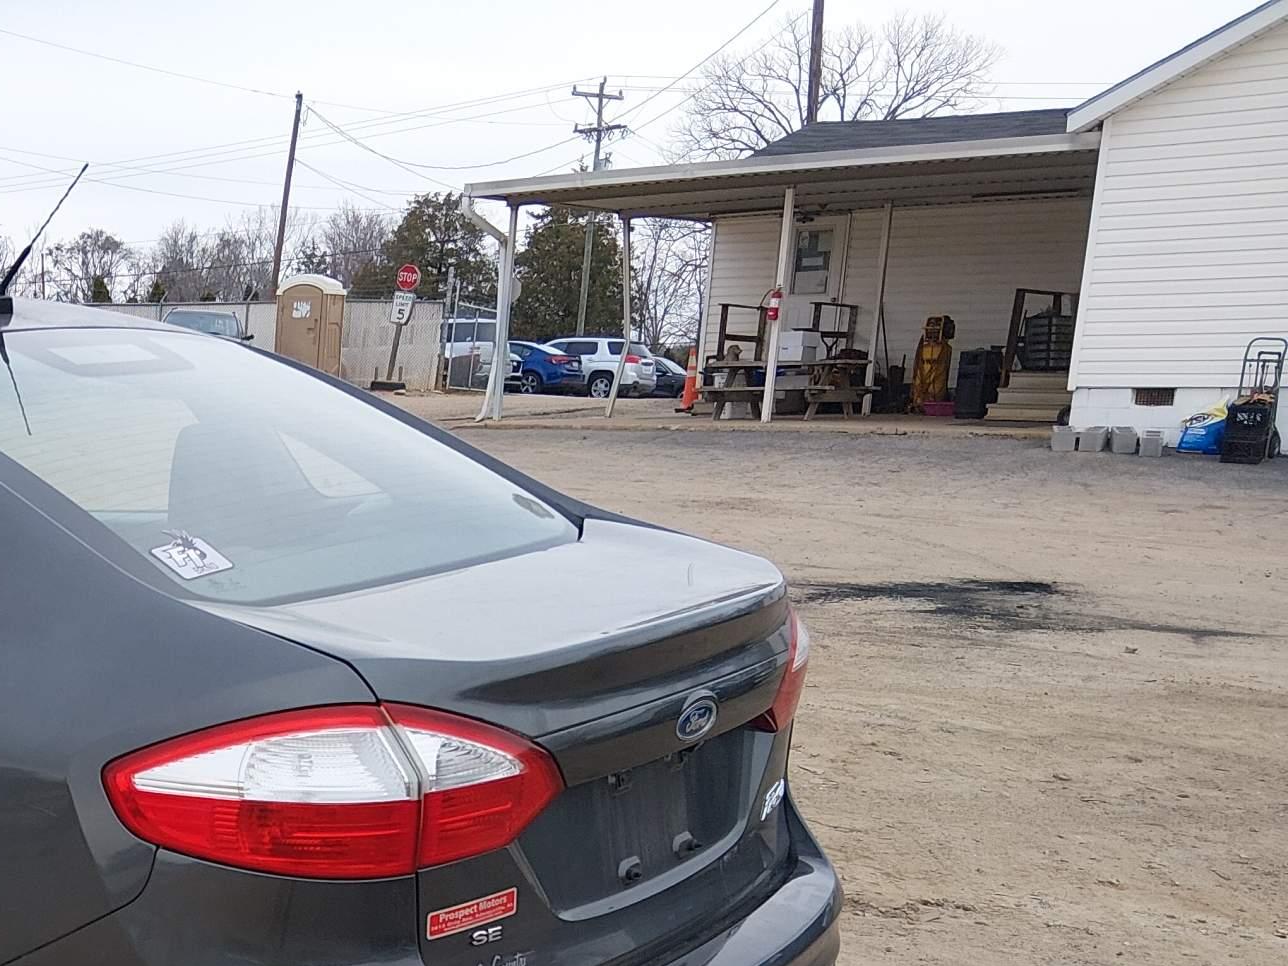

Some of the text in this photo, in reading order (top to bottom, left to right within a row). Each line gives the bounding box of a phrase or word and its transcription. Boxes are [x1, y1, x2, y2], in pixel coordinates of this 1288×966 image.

[399, 272, 418, 283] STOP
[396, 308, 405, 321] 5
[439, 904, 478, 923] Prospect
[479, 895, 508, 912] Motors
[471, 926, 503, 946] SE
